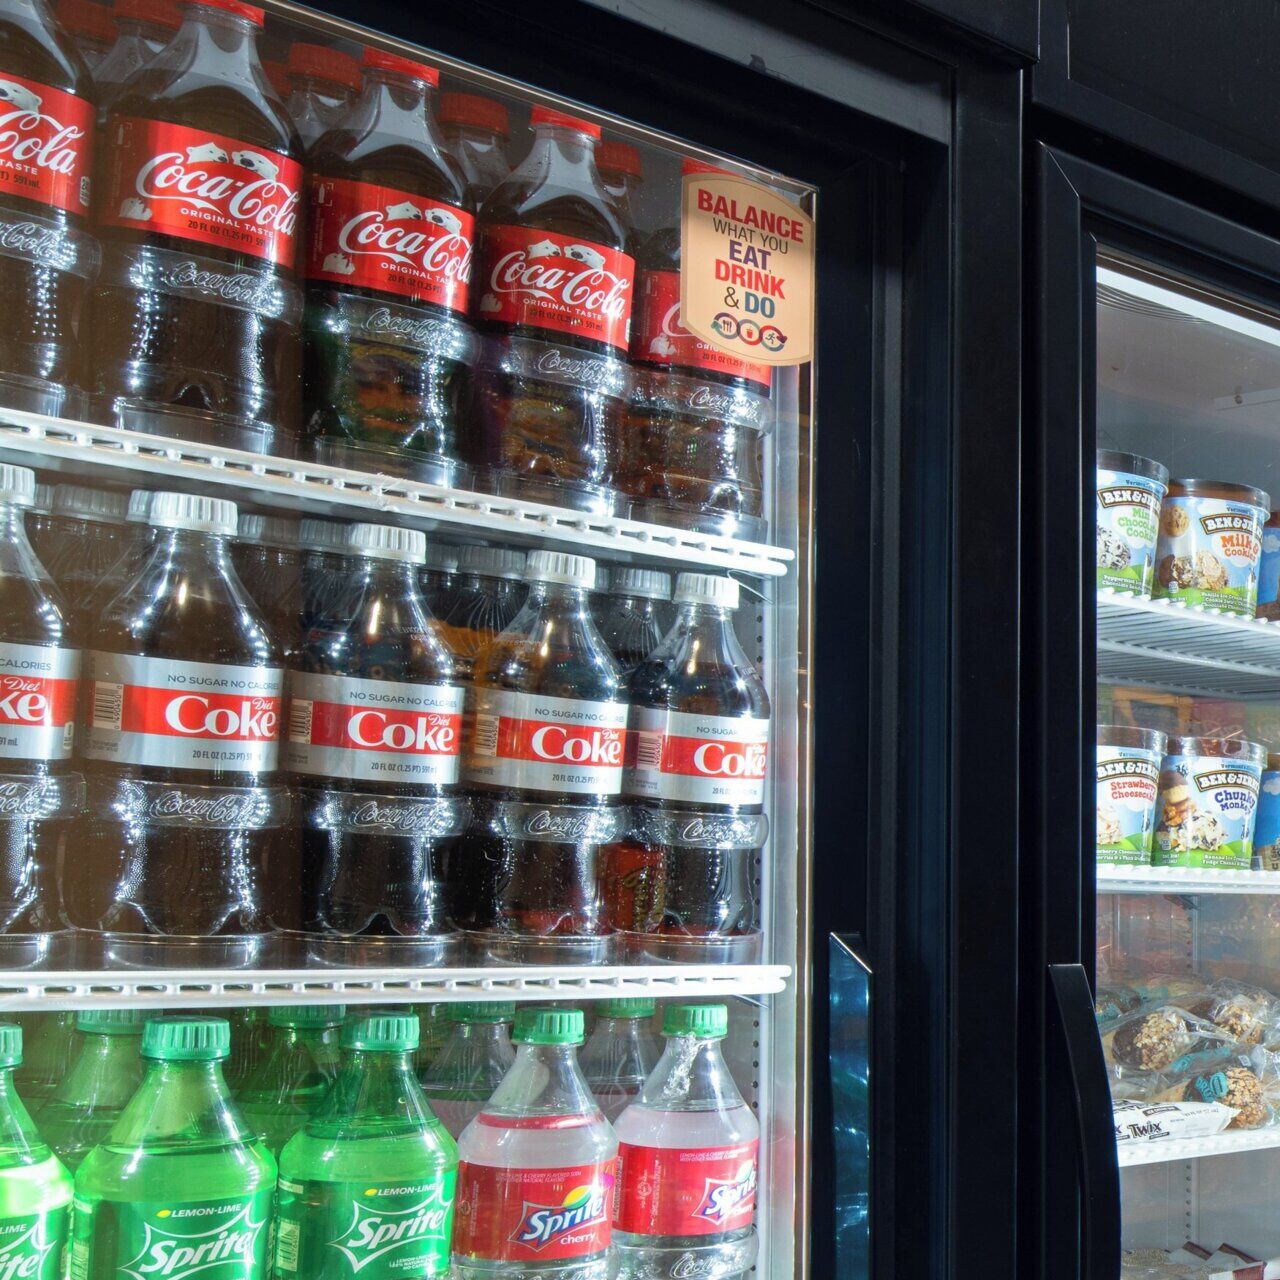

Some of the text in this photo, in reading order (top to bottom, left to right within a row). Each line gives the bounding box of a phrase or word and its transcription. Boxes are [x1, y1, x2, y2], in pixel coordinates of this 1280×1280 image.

[180, 207, 240, 228] ORIGINAL
[698, 188, 804, 243] BALANCE
[713, 217, 789, 255] WHAT YOU
[381, 262, 432, 280] ORIGINAL
[715, 259, 785, 299] DRINK
[523, 297, 574, 312] ORIGINAL
[724, 286, 775, 319] & DO
[4, 676, 41, 692] Diet
[167, 674, 245, 689] NO SUGAR NO
[350, 691, 422, 705] NO SUGAR NO
[165, 695, 277, 738] Coke
[535, 708, 550, 716] NO
[551, 710, 583, 720] SUGAR
[347, 711, 455, 752] Coke
[532, 726, 622, 764] Coke
[1127, 1120, 1162, 1139] Twix
[171, 1203, 242, 1218] LEMON-LIME
[522, 1195, 604, 1247] Sprite
[347, 1209, 444, 1250] Sprite
[560, 1233, 596, 1245] cherry
[138, 1230, 251, 1275] Sprite
